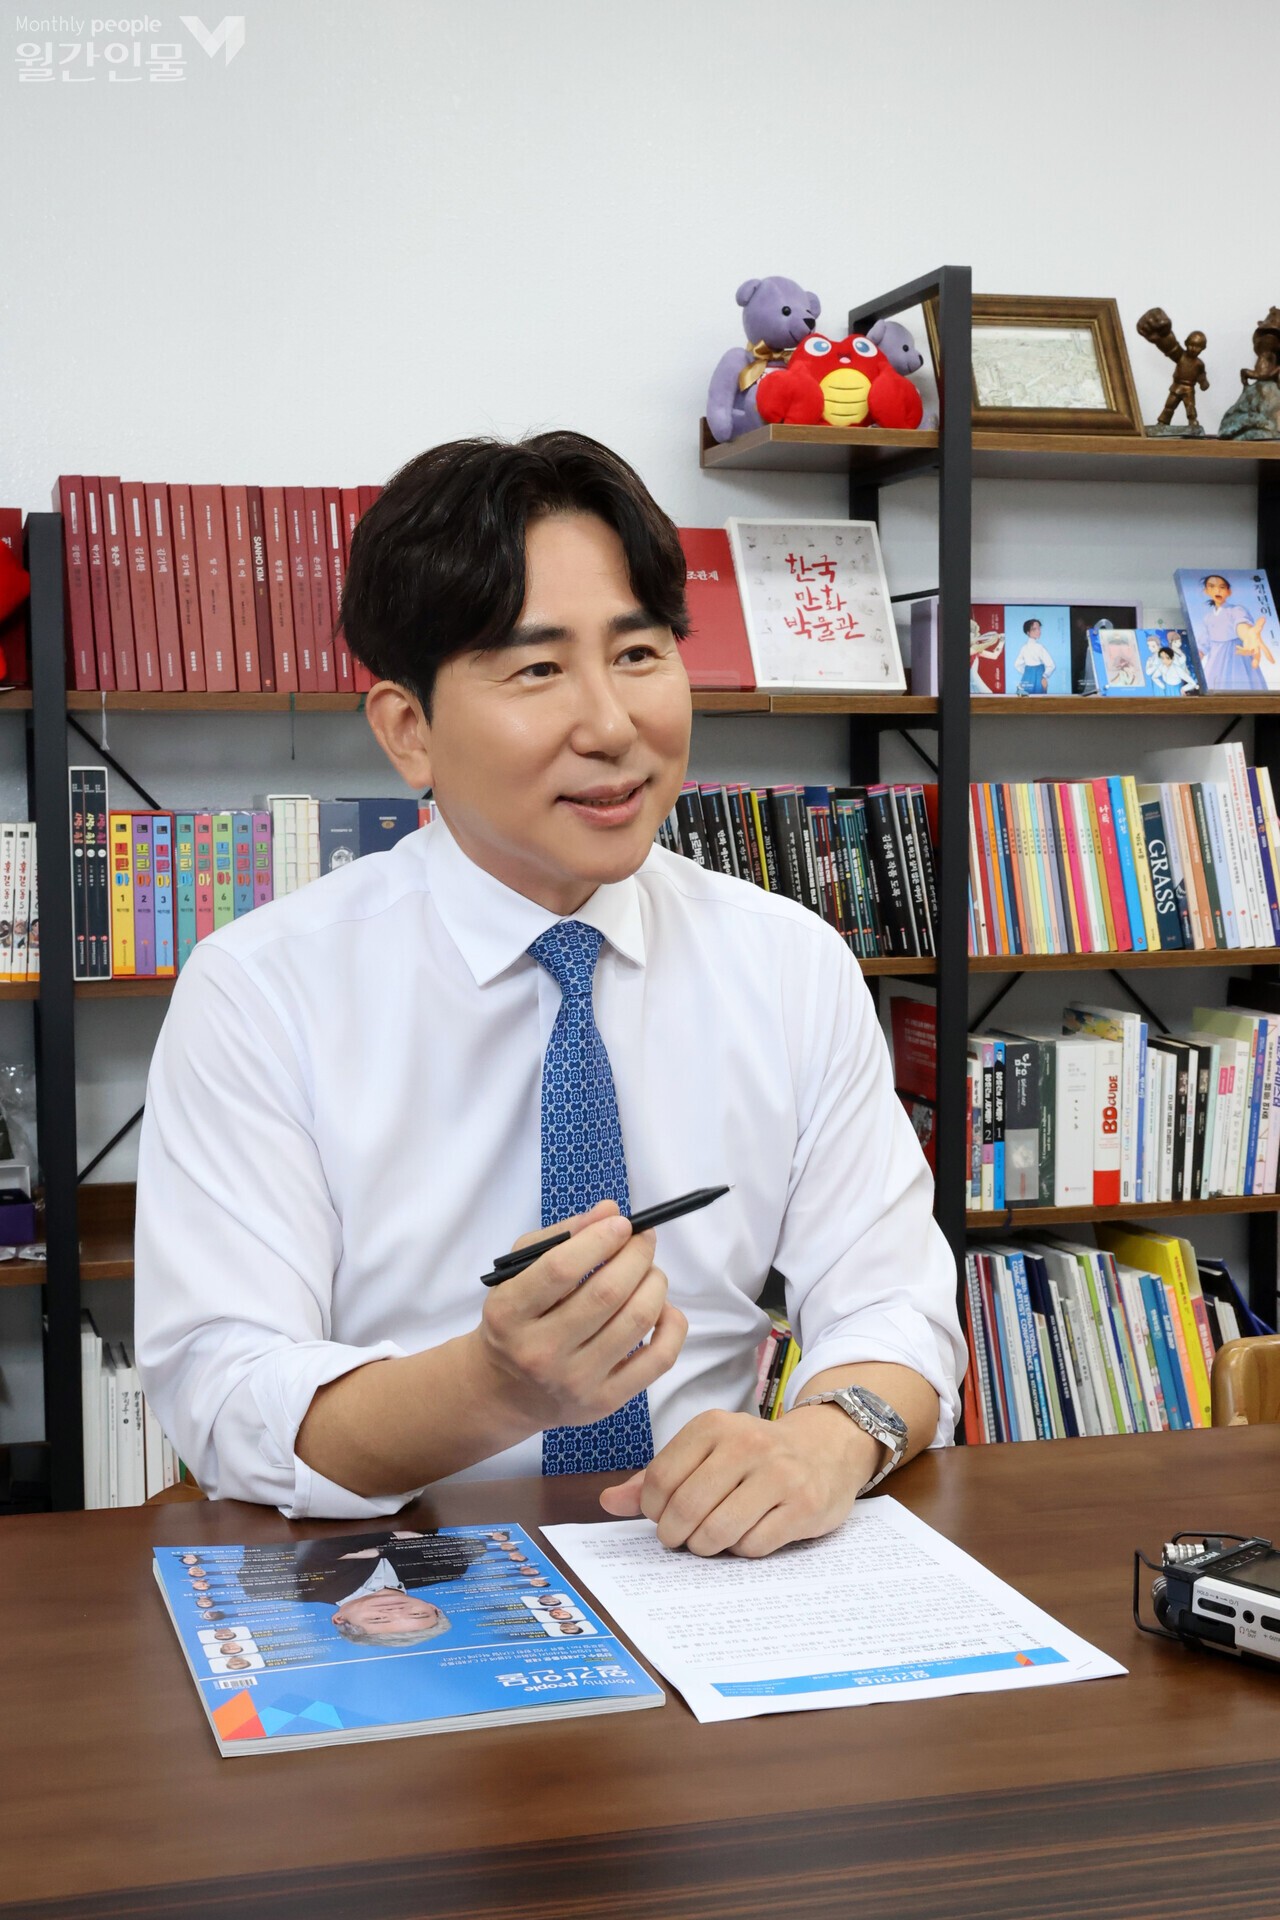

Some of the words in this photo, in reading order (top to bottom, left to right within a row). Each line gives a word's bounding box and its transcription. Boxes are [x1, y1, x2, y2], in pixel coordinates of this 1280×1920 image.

[253, 536, 263, 565] SANHO
[255, 566, 265, 582] KIM
[785, 552, 838, 583] 한국
[795, 585, 847, 612] 만화
[1253, 583, 1272, 617] 정년이
[783, 607, 866, 643] 박물관
[716, 829, 727, 846] 만화
[881, 833, 895, 859] 김종래
[886, 860, 898, 879] 작품
[1148, 839, 1176, 914] GRASS
[121, 894, 125, 902] 1
[184, 894, 190, 902] 4
[202, 894, 207, 902] 5
[221, 893, 227, 901] 6
[241, 894, 246, 902] 7
[889, 879, 901, 898] 도록
[913, 884, 923, 904] 이야기
[141, 895, 147, 903] 2
[161, 896, 166, 904] 3
[1014, 1053, 1032, 1077] 담요
[985, 1129, 992, 1141] 2
[997, 1127, 1001, 1139] 1
[1010, 1260, 1021, 1287] COMIC
[1015, 1288, 1026, 1317] ARTIST
[1016, 1259, 1025, 1274] THE
[1022, 1294, 1039, 1358] INTERNATIONAL
[1019, 1318, 1035, 1372] CONFERENCE
[1184, 1551, 1221, 1567] TASCAM
[1196, 1589, 1209, 1597] HOLD
[495, 1664, 628, 1687] 월간인물
[581, 1678, 636, 1688] Monthly
[523, 1681, 579, 1692] people
